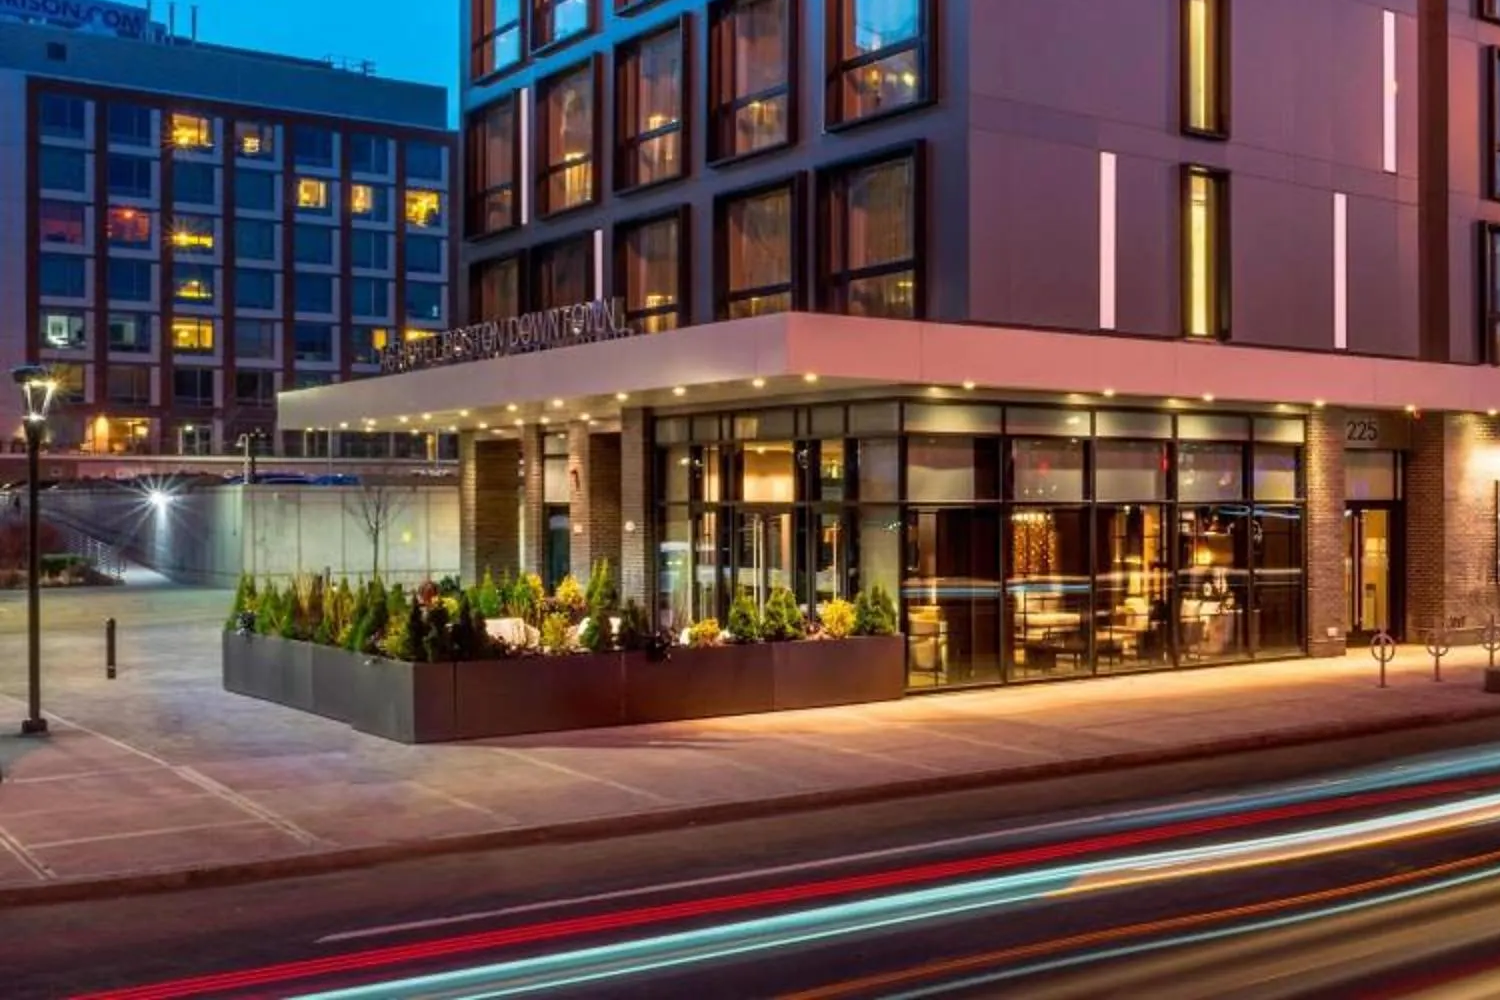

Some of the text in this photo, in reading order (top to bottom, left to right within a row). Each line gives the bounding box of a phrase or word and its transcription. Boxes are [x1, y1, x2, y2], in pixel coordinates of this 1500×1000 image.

[442, 321, 504, 358] BOSTON
[508, 297, 617, 346] DOWNTOWN
[1347, 421, 1378, 441] 225
